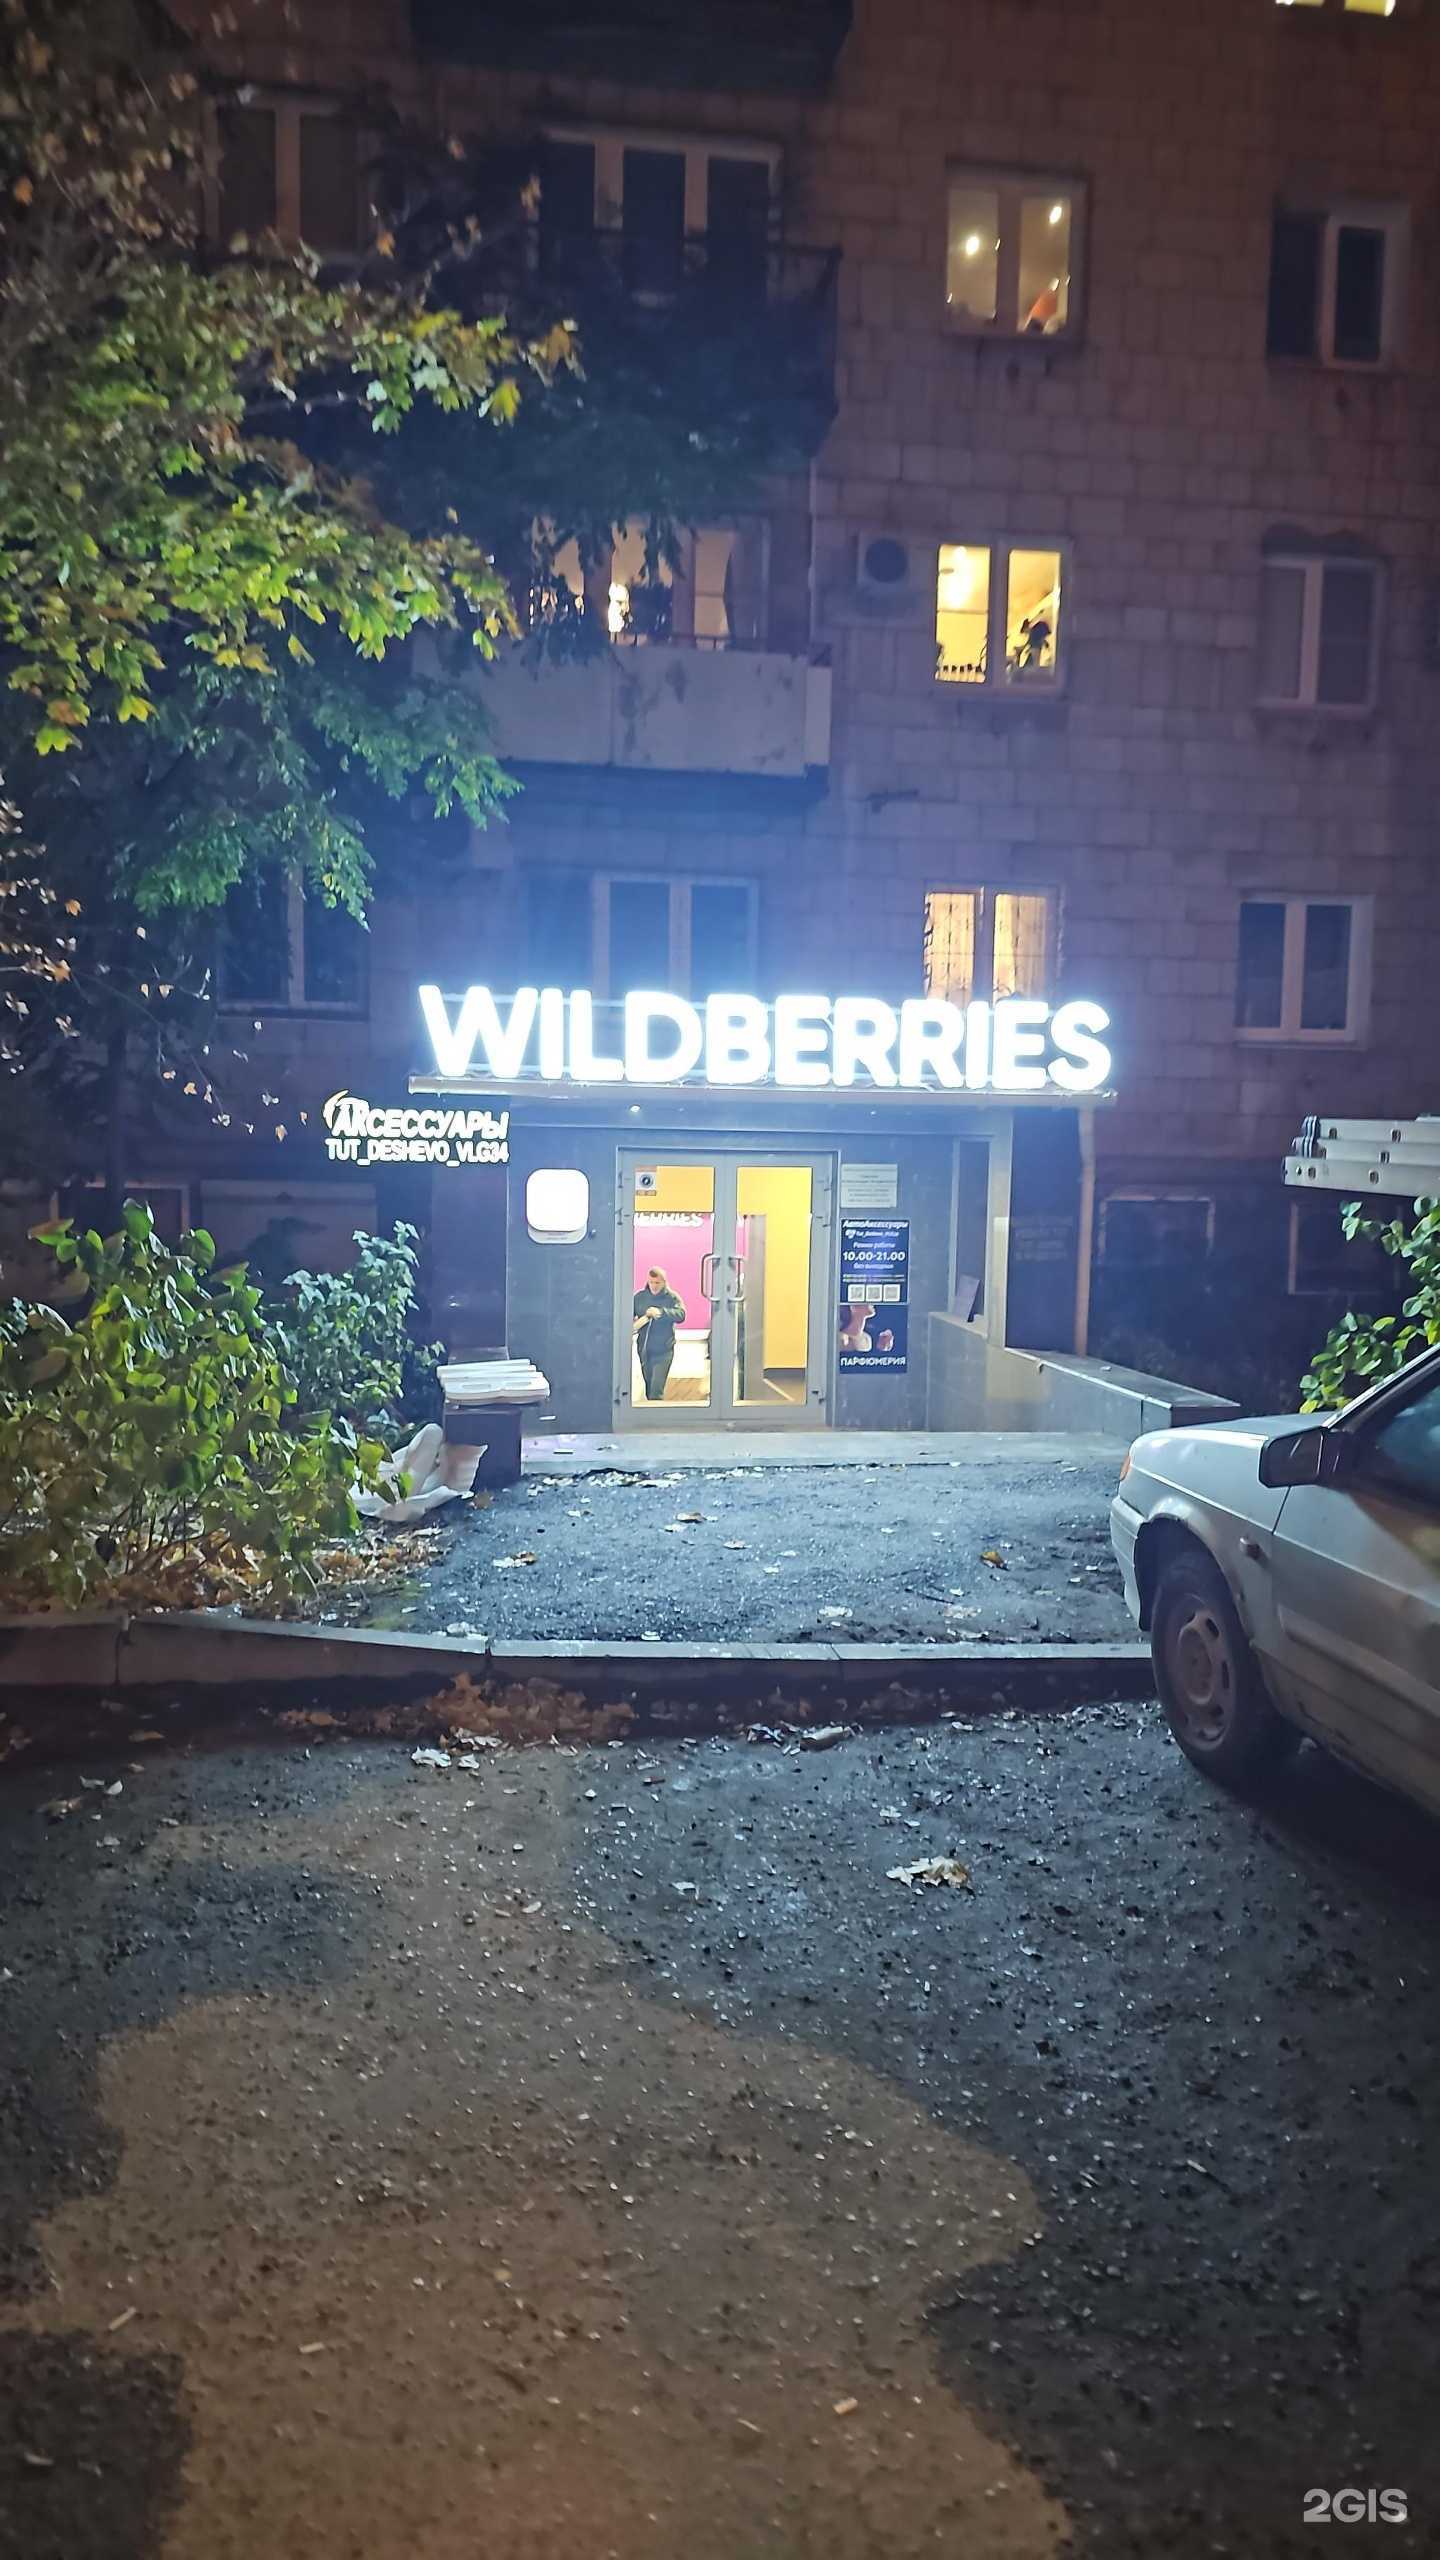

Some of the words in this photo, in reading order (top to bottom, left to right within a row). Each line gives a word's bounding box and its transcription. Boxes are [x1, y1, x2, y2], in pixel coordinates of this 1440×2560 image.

[418, 985, 1112, 1092] WILDBERRIES
[325, 1138, 510, 1167] TUT_DESHEVO_VLG34
[843, 1251, 906, 1261] 10.00-21.00
[840, 1356, 906, 1366] ПАРФЮМЕРИЯ
